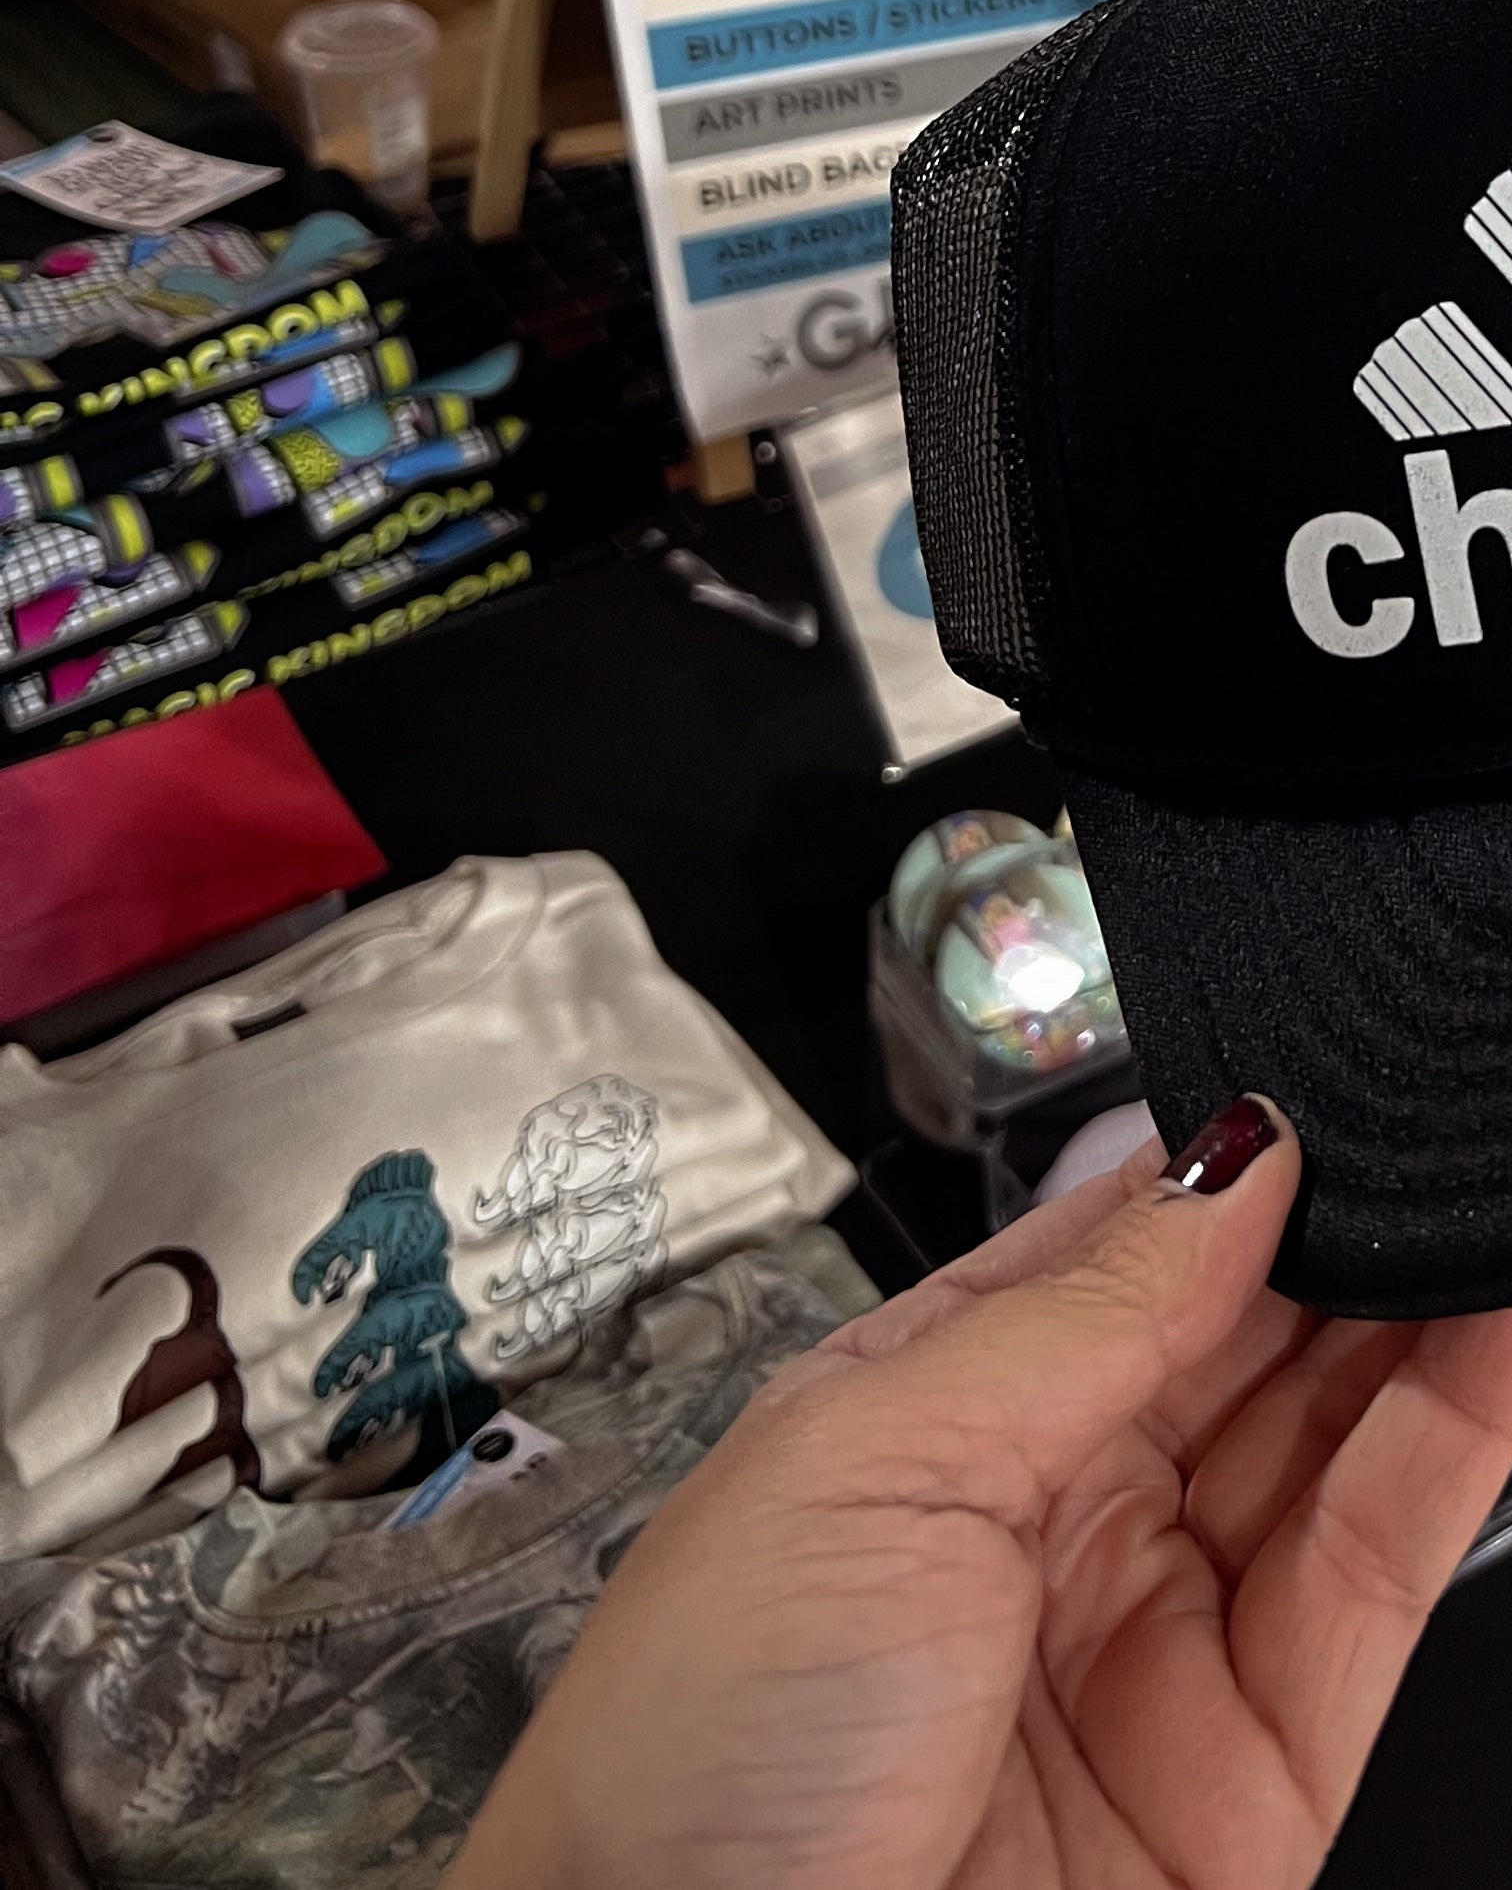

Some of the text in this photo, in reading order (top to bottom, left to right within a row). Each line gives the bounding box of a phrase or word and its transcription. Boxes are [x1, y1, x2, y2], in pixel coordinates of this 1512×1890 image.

[685, 12, 858, 63] BUTTONS
[694, 73, 903, 137] ART PRINTS
[700, 161, 813, 211] BLIND
